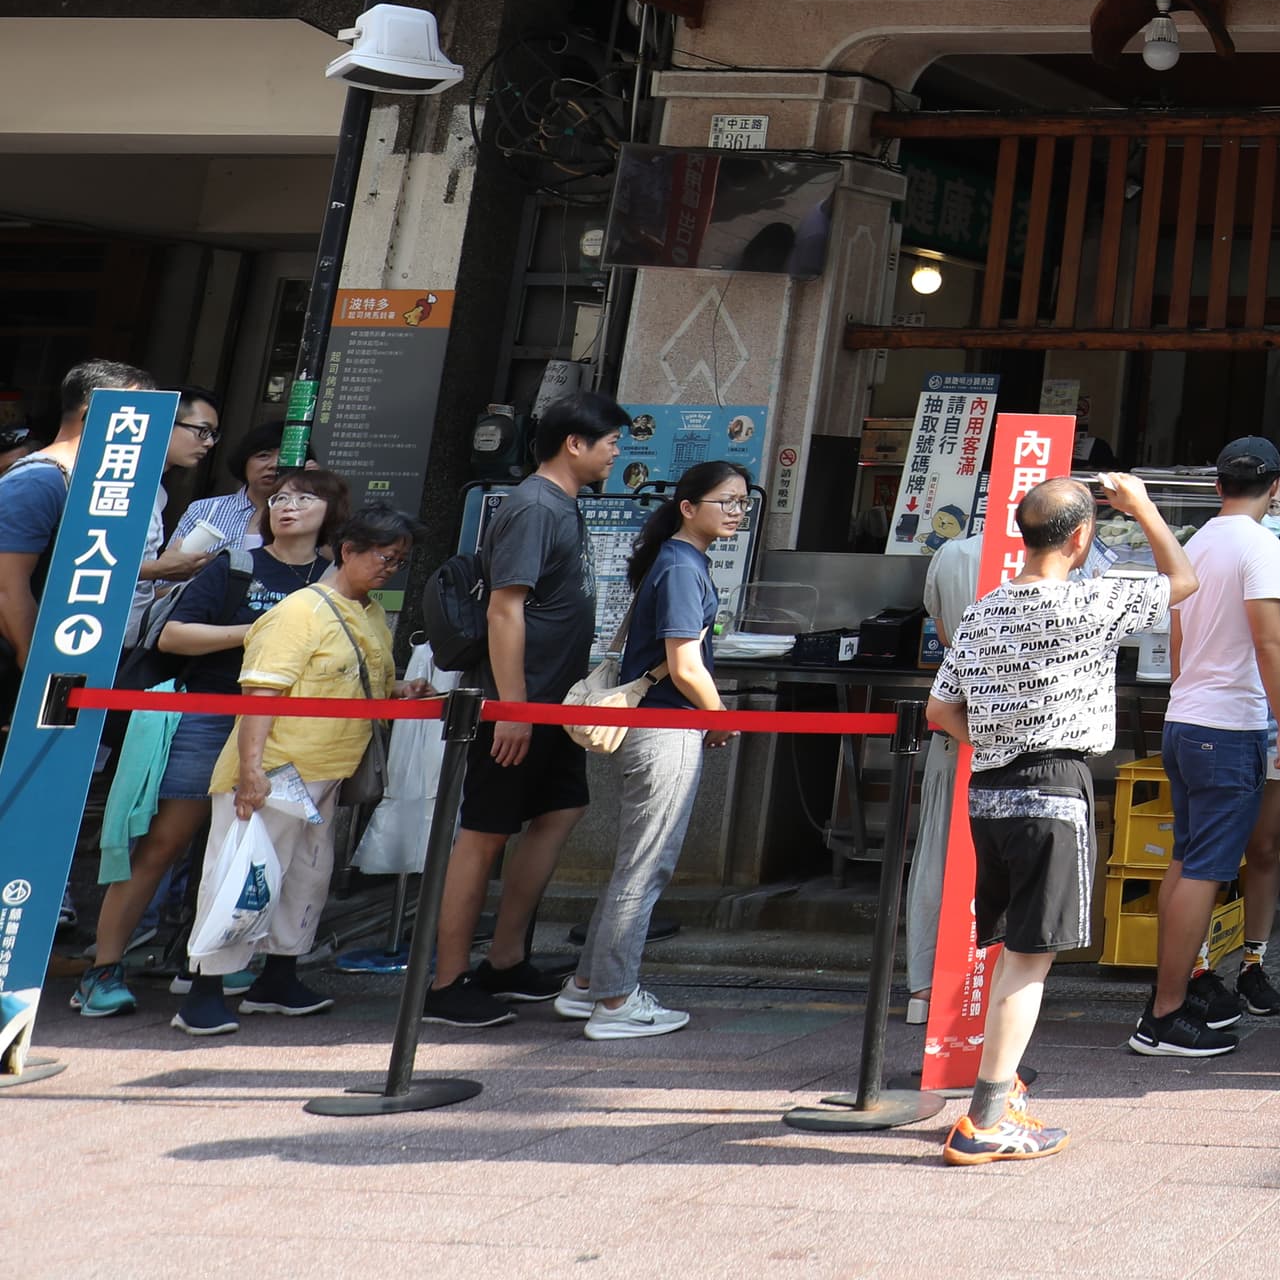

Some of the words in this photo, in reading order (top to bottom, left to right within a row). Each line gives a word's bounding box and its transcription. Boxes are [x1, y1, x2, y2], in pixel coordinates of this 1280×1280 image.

[727, 119, 762, 130] 中正路
[724, 133, 751, 150] 361
[349, 297, 390, 311] 波特多
[938, 395, 967, 455] 請自行
[956, 397, 988, 477] 內用客滿
[905, 395, 943, 495] 抽取號碼牌
[88, 406, 150, 517] 內用區
[67, 529, 118, 605] 入口
[1007, 587, 1041, 598] PUMA
[983, 606, 1017, 618] PUMA
[1000, 623, 1031, 635] PUMA
[1045, 614, 1089, 630] PUMA
[960, 627, 989, 641] PUMA
[980, 644, 1008, 657] PUMA
[1020, 639, 1061, 652] PUMA
[1045, 649, 1090, 667] PUMA
[996, 662, 1030, 675] PUMA
[970, 684, 1008, 696] PUMA
[1019, 675, 1059, 691] PUMA
[991, 700, 1029, 713] PUMA
[1015, 713, 1053, 728] PUMA
